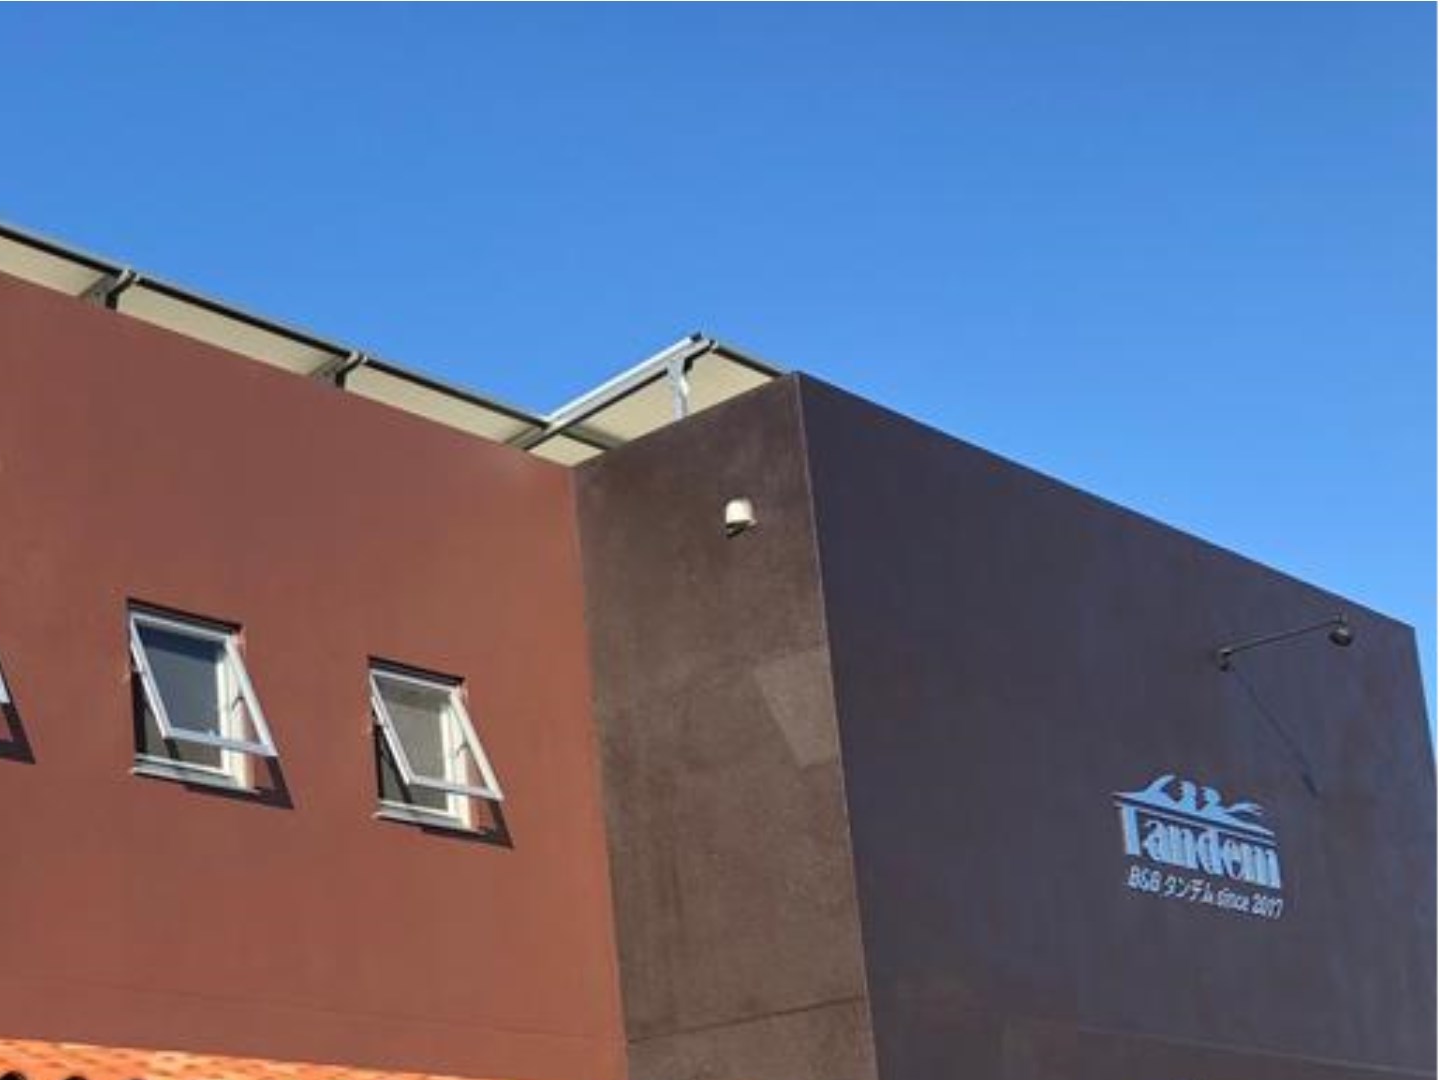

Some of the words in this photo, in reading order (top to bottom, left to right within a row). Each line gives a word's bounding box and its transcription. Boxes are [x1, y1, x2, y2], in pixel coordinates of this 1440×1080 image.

[1114, 802, 1281, 889] Tandem
[1164, 875, 1213, 902] タンデム
[1217, 887, 1250, 913] since
[1251, 892, 1284, 919] 2017
